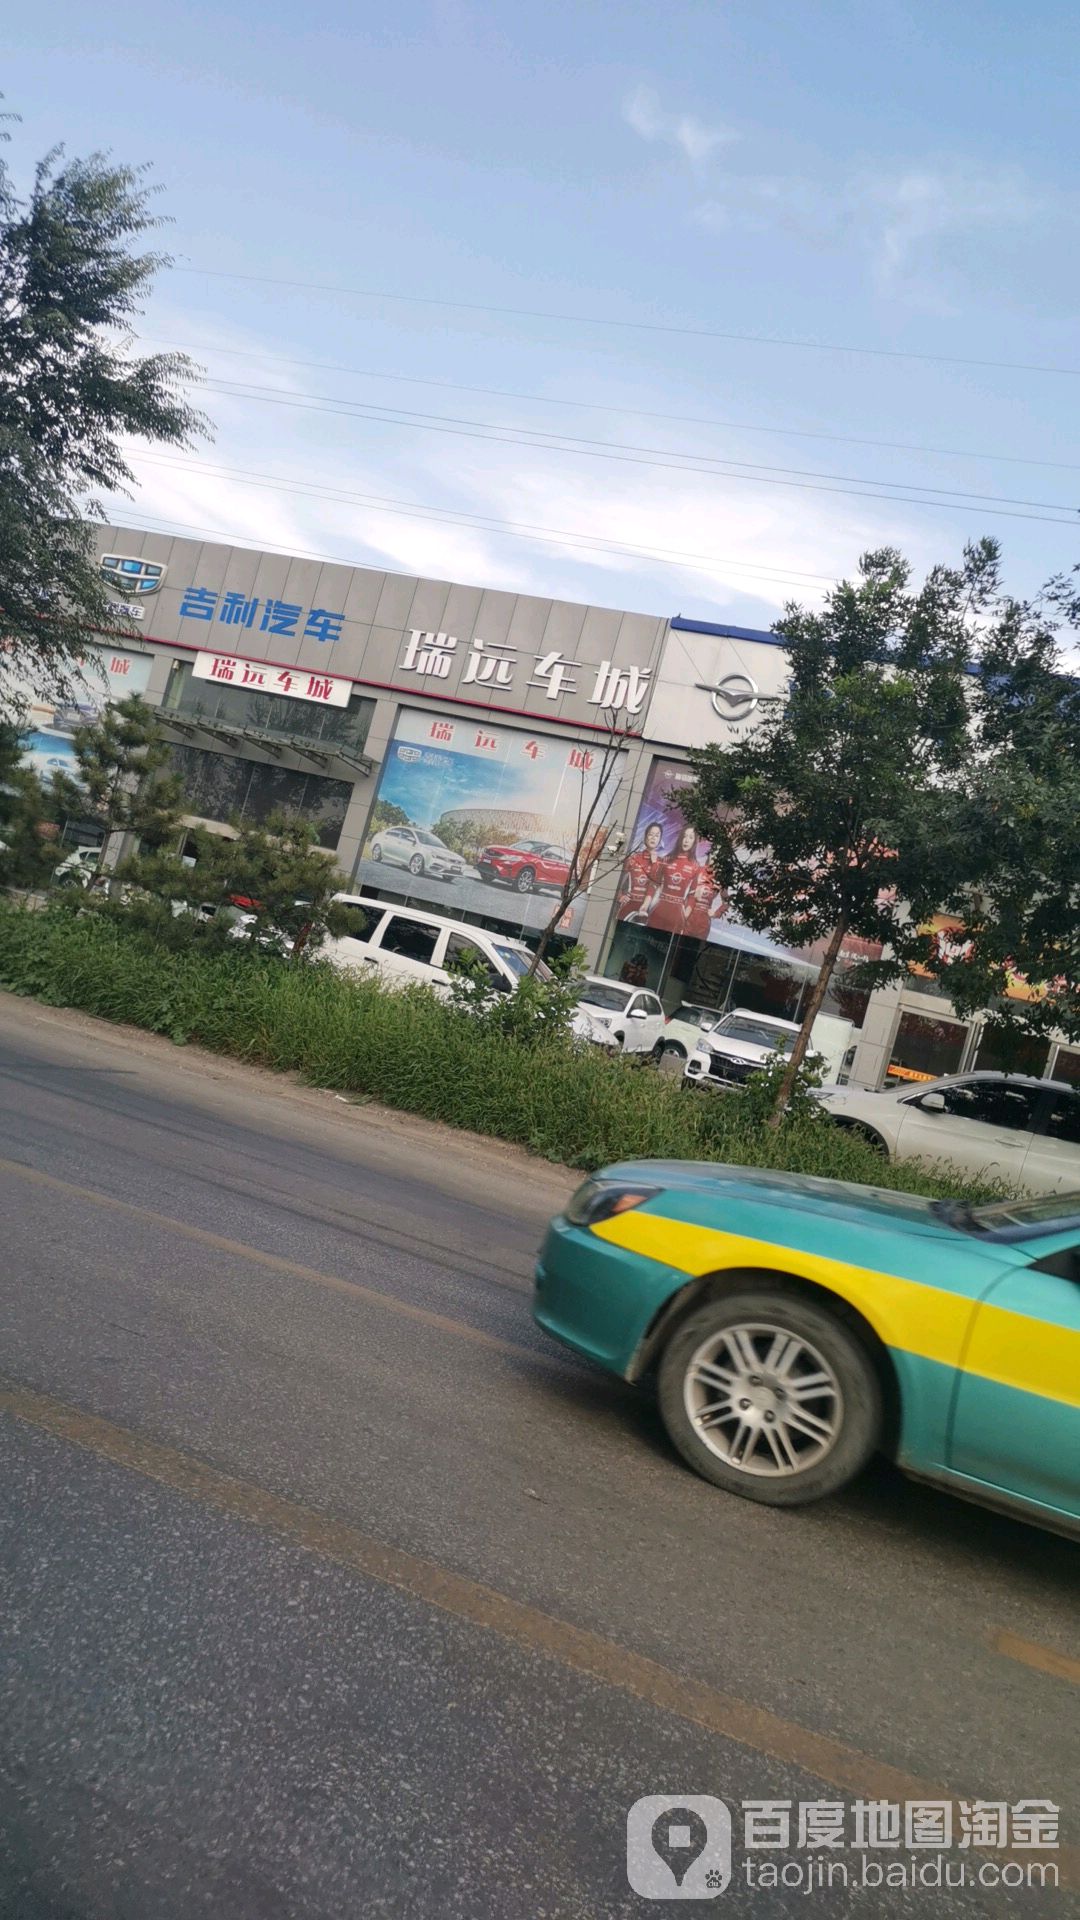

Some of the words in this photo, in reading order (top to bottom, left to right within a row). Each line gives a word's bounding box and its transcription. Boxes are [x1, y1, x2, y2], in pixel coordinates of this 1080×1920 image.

[179, 587, 346, 643] 吉利汽车
[210, 657, 335, 701] 瑞远车城
[399, 628, 654, 715] 瑞远车城
[428, 721, 596, 770] 瑞远车城
